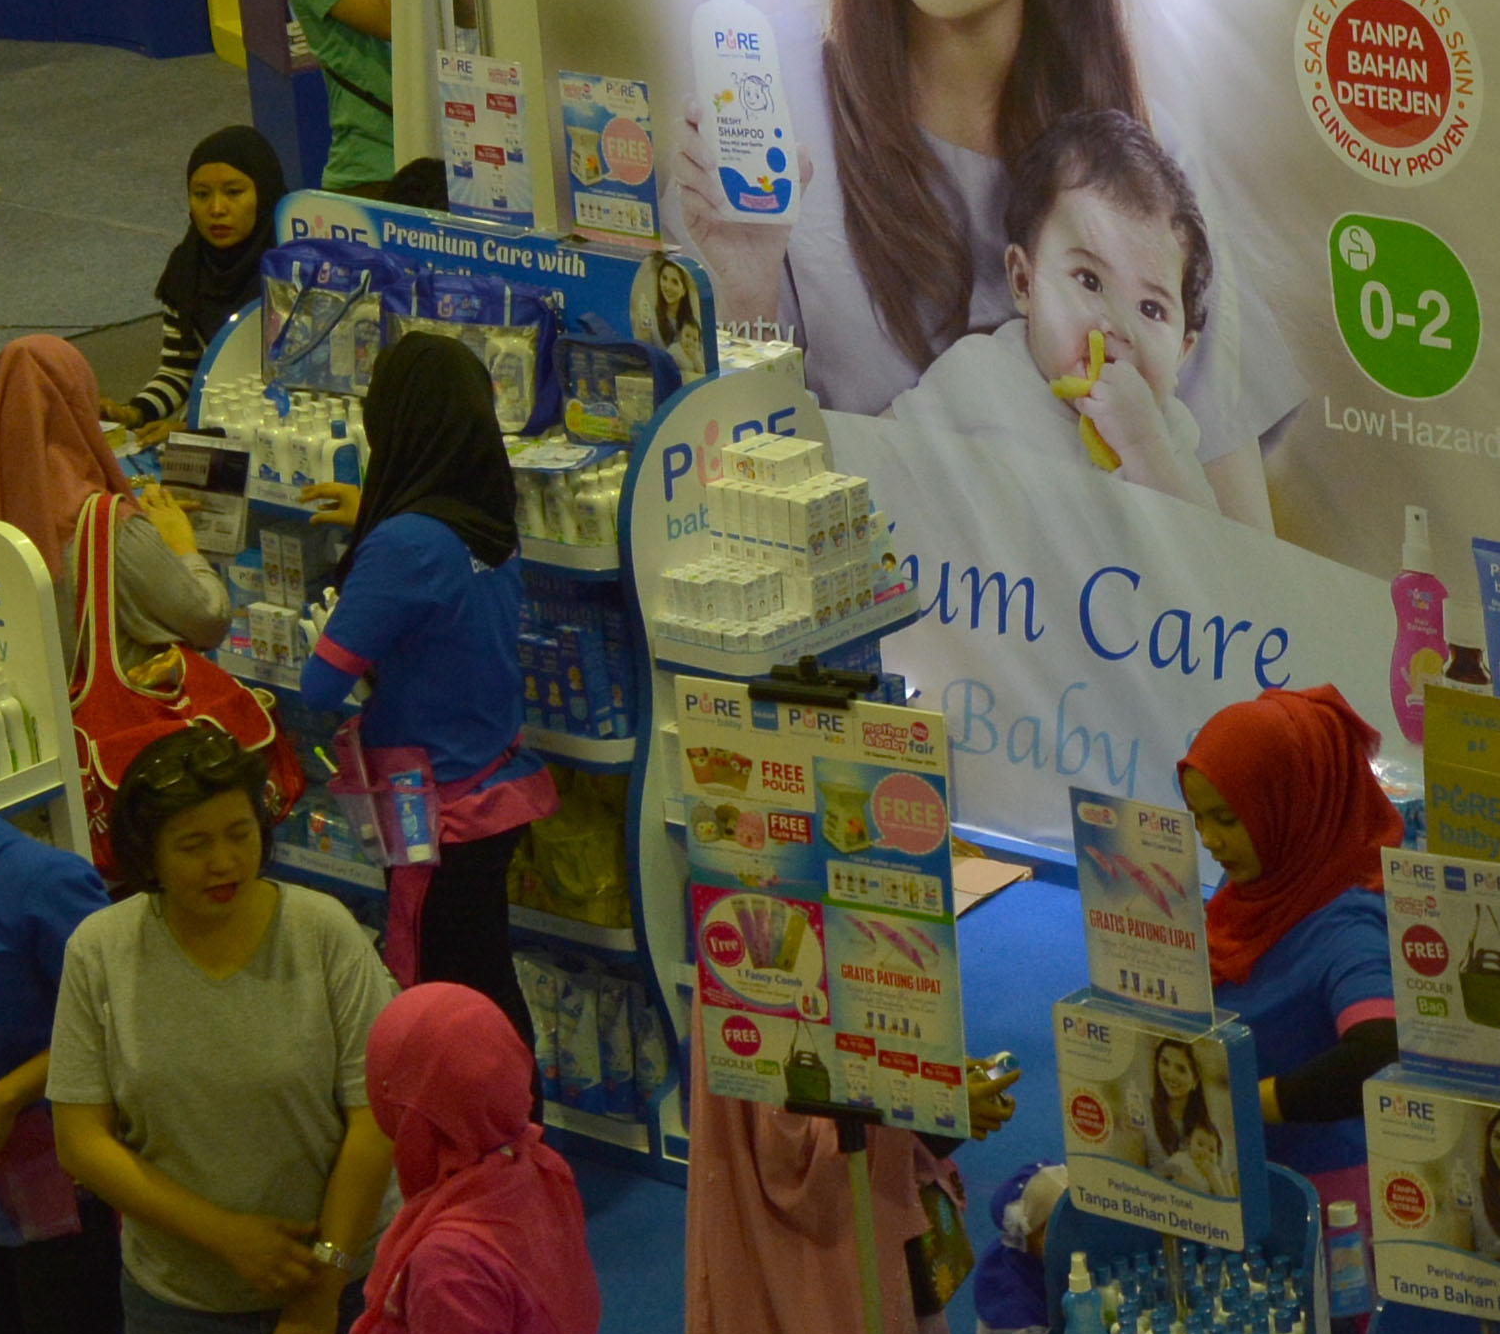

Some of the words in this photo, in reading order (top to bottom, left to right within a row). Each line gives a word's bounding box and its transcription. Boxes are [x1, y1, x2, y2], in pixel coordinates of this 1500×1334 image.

[714, 28, 760, 51] PURE
[1347, 18, 1425, 51] TANPA
[1305, 4, 1331, 76] SAFE
[1446, 31, 1474, 96] SKIN
[1347, 50, 1428, 84] BAHAN
[1337, 80, 1443, 117] DETERJEN
[718, 126, 765, 140] SHAMPOO
[1311, 94, 1402, 178] CLINICALLY
[1407, 114, 1470, 177] PROVEN
[606, 136, 649, 162] FREE
[381, 221, 479, 264] Premium
[483, 240, 532, 267] Care
[538, 251, 587, 278] with
[1360, 279, 1454, 351] 0-2
[1323, 394, 1386, 437] Low
[1078, 566, 1292, 691] Care
[685, 692, 742, 718] PURE
[788, 707, 845, 734] PURE
[941, 677, 1140, 791] Baby
[761, 760, 805, 783] FREE
[762, 777, 806, 795] POUCH
[769, 814, 808, 833] FREE
[879, 798, 940, 828] FREE
[1138, 810, 1182, 837] PURE
[1390, 859, 1437, 881] PURE
[1089, 907, 1124, 935] GRATIS
[1127, 915, 1168, 945] PAYUNG
[1168, 923, 1197, 951] LIPAT
[1404, 941, 1446, 960] FREE
[840, 963, 875, 984] GRATIS
[876, 969, 915, 991] PAYUNG
[915, 976, 942, 995] LIPAT
[1406, 978, 1453, 995] COOLER
[724, 1027, 759, 1044] FREE
[1062, 1016, 1111, 1045] PURE
[1379, 1094, 1435, 1121] PURE
[1077, 1186, 1119, 1213] Tanpa
[1123, 1199, 1166, 1224] Bahan
[1168, 1211, 1230, 1244] Deterjen
[1169, 1195, 1193, 1211] Total
[1390, 1274, 1439, 1299] Tanpa
[1443, 1287, 1494, 1310] Bahan
